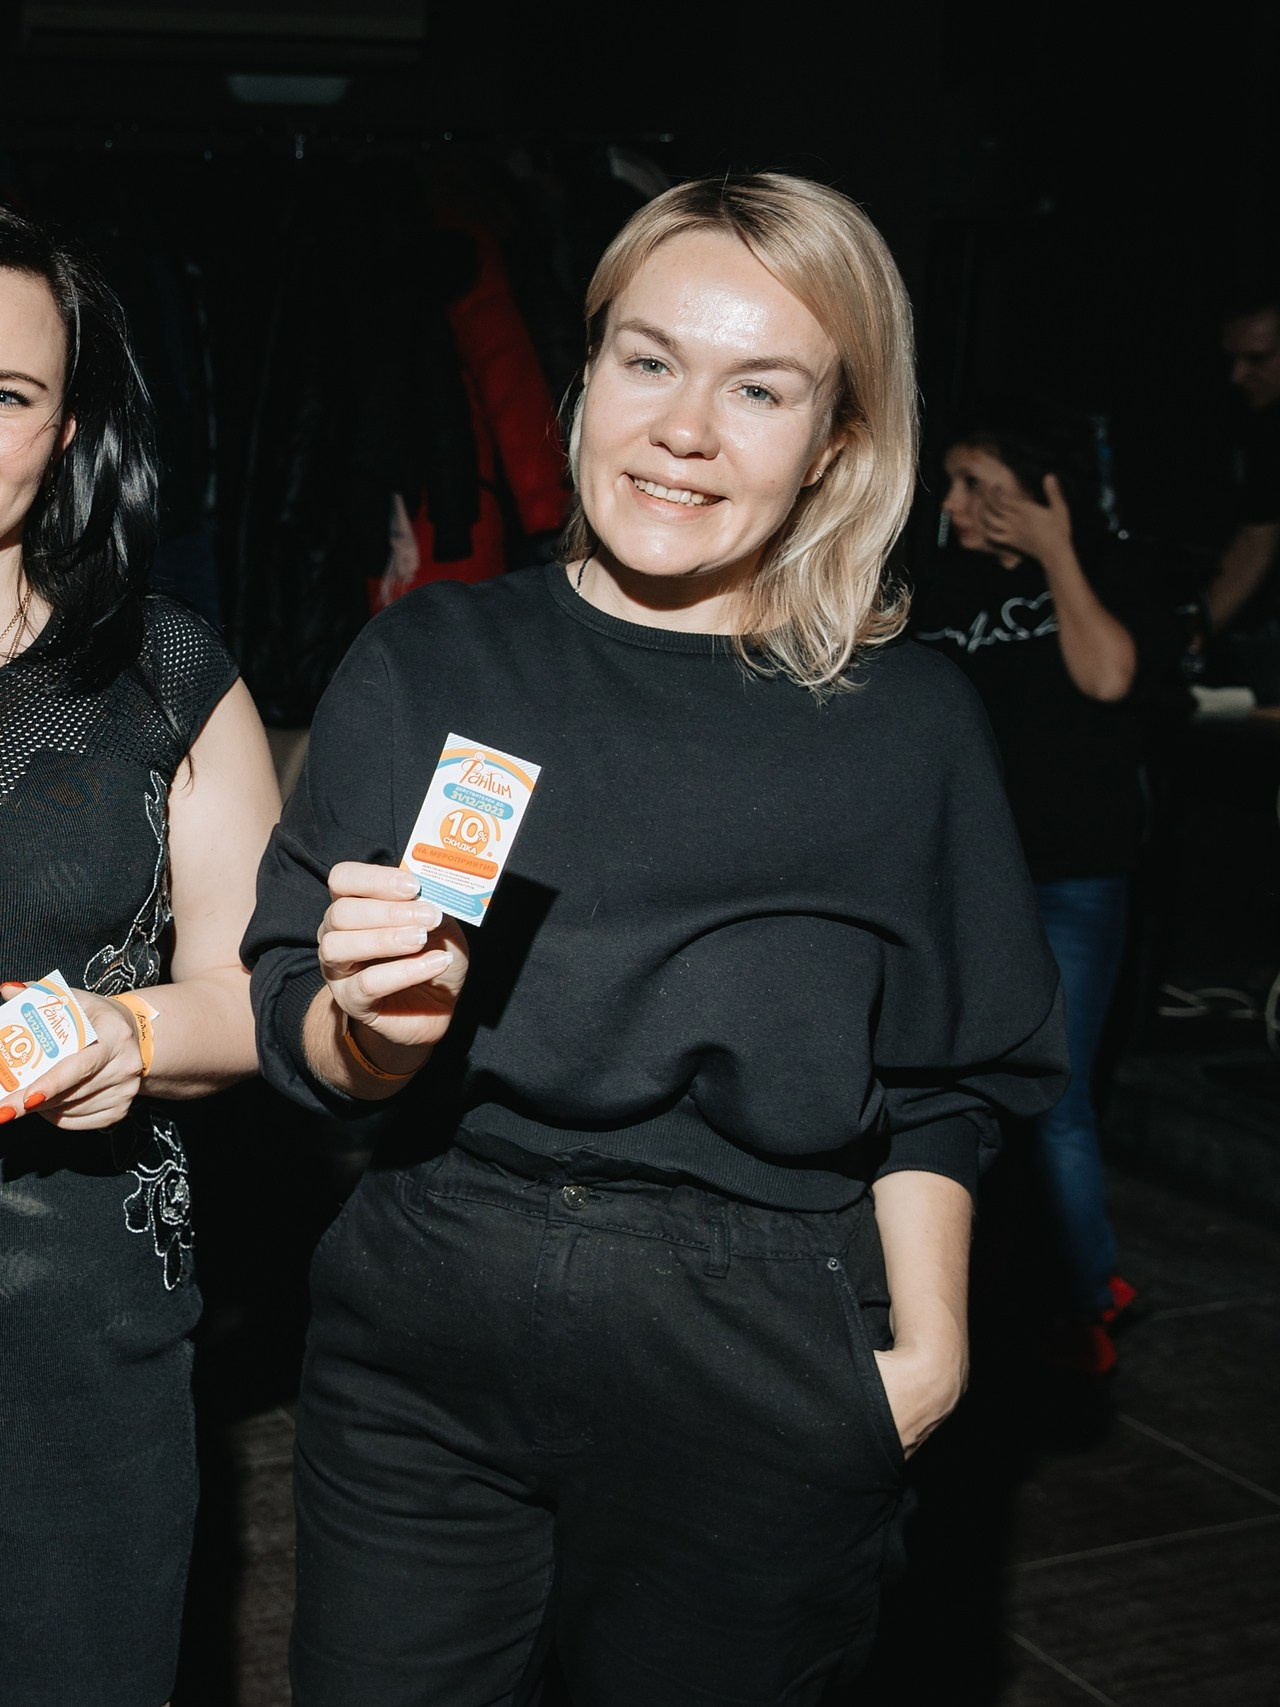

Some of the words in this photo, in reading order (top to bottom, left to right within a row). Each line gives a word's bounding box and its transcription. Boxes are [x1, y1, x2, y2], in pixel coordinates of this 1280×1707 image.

[450, 790, 505, 817] 31/12/2023
[448, 810, 488, 844] 10%
[443, 836, 477, 855] СКИДКА
[415, 847, 429, 857] НА
[430, 851, 497, 873] МЕРОПРИЯТИЕ
[24, 1010, 53, 1054] 31/12/2023
